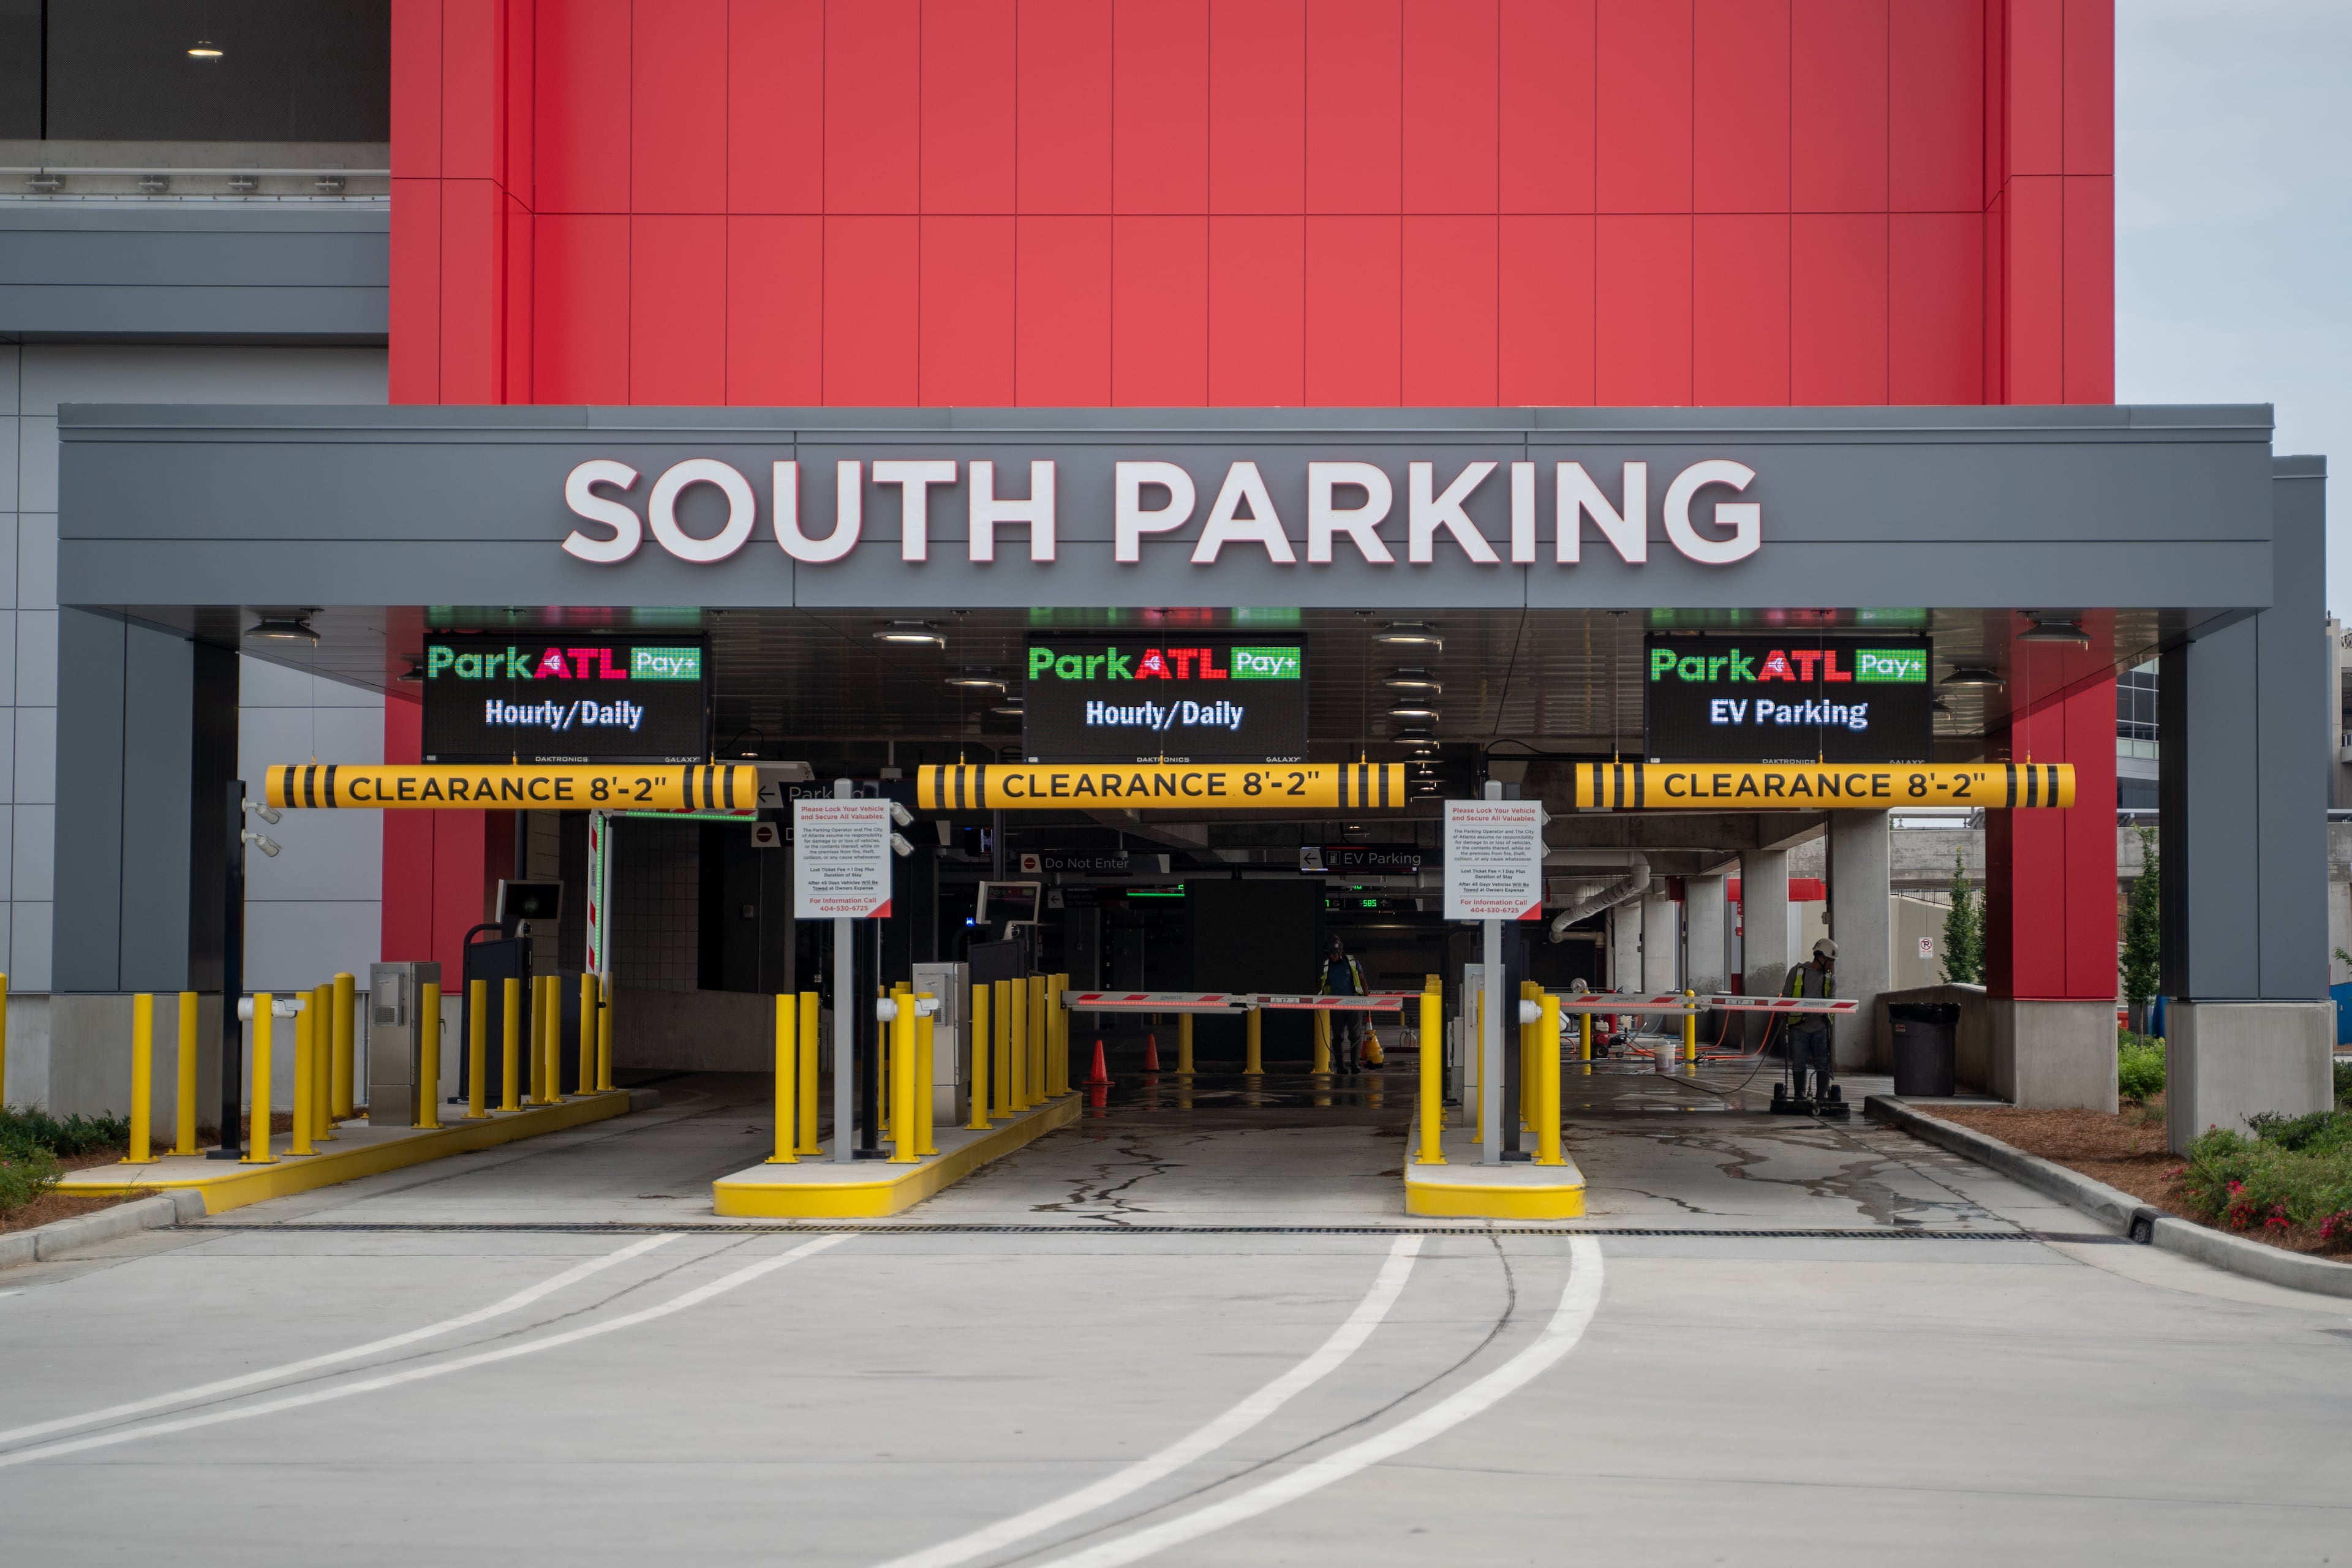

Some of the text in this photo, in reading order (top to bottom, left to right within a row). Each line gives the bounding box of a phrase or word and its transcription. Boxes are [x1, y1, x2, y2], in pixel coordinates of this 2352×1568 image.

[562, 459, 1761, 565] SOUTH PARKING
[637, 652, 696, 676] Pay+
[1237, 652, 1297, 677] Pay+
[1862, 655, 1921, 678] Pay+
[486, 700, 643, 729] Hourly/Daily
[1087, 700, 1243, 729] Hourly/Daily
[1711, 699, 1868, 729] EV Parking
[349, 777, 666, 801] CLEARANCE 8'-2"
[790, 786, 864, 802] Parkg
[1002, 772, 1319, 797] CLEARANCE 8'-2"
[1664, 773, 1985, 797] CLEARANCE 8'-2"
[1046, 858, 1129, 869] Do Not Enter
[1344, 852, 1422, 865] EV Parking
